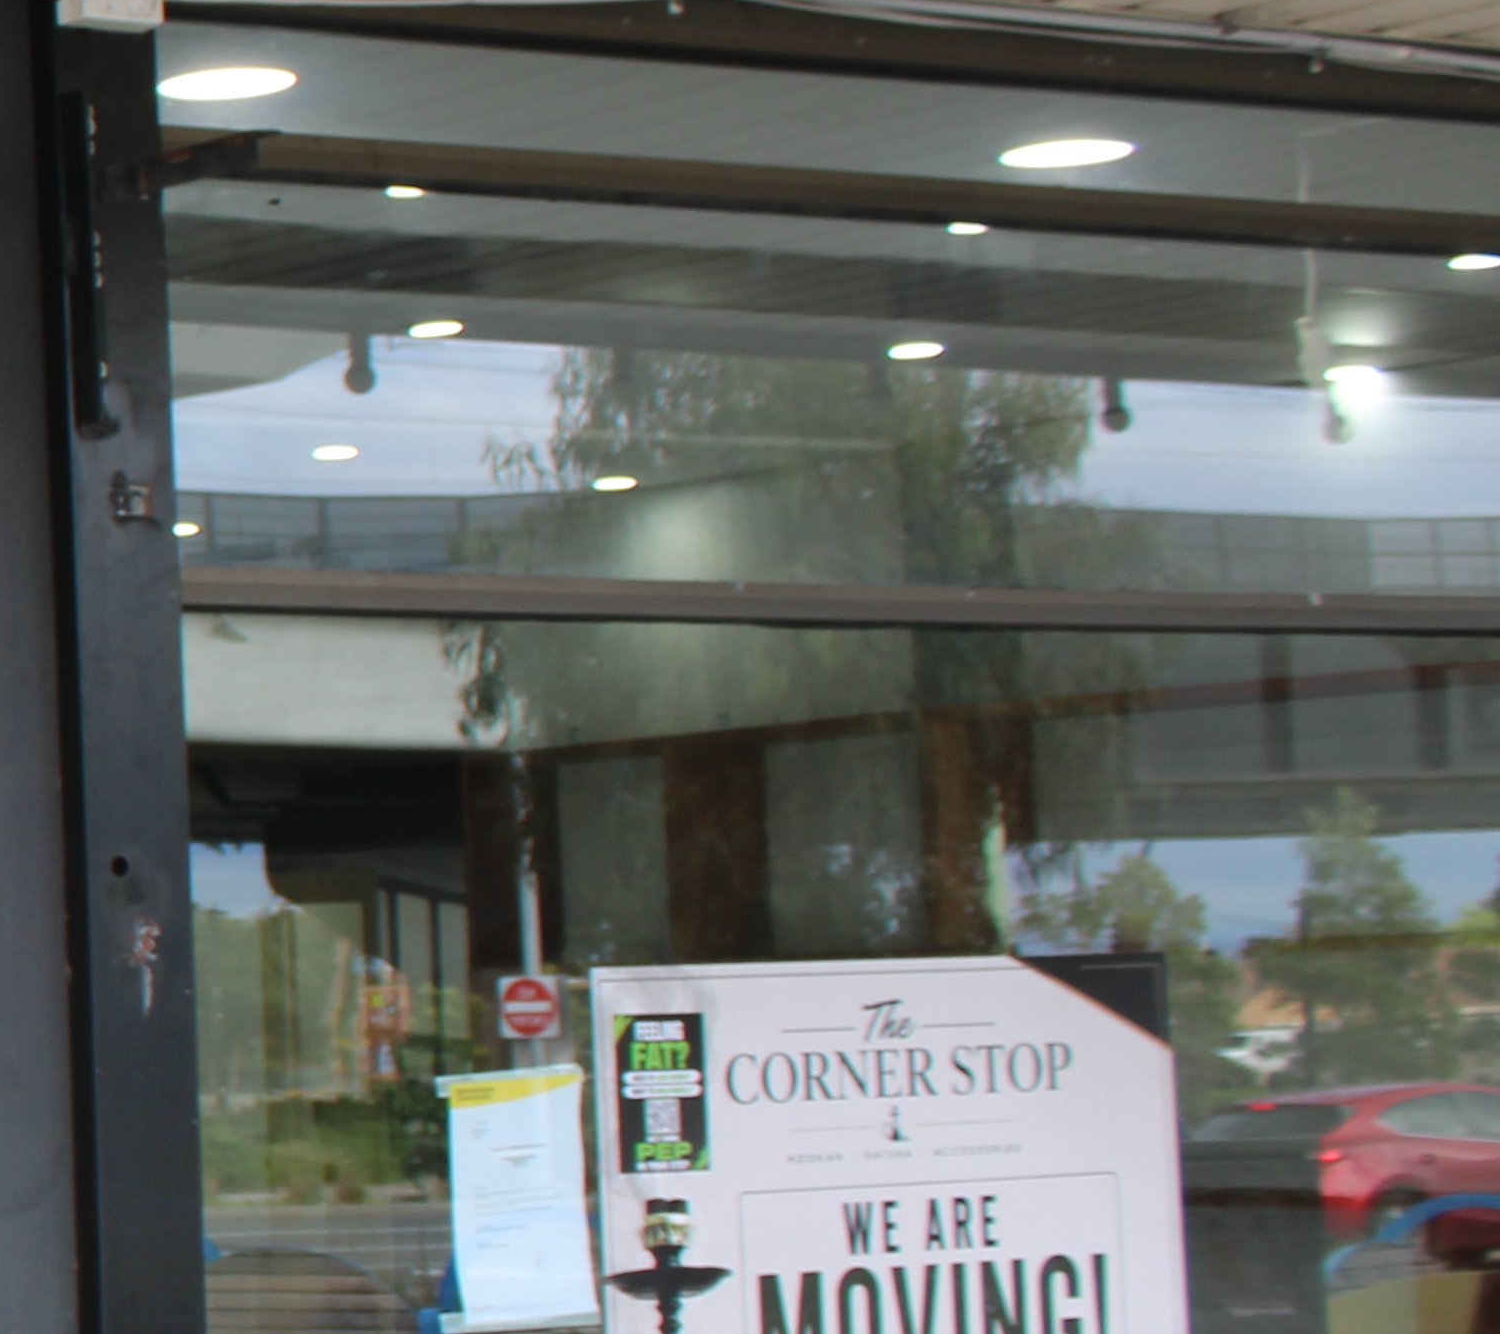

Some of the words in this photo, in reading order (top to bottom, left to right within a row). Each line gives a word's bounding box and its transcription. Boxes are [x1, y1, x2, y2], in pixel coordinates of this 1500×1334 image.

[861, 998, 914, 1044] The
[629, 1041, 691, 1070] FAT?
[724, 1046, 938, 1106] CORNER
[950, 1040, 1074, 1097] STOP
[635, 1140, 694, 1161] PEP
[843, 1200, 901, 1256] WE
[925, 1195, 999, 1251] ARE
